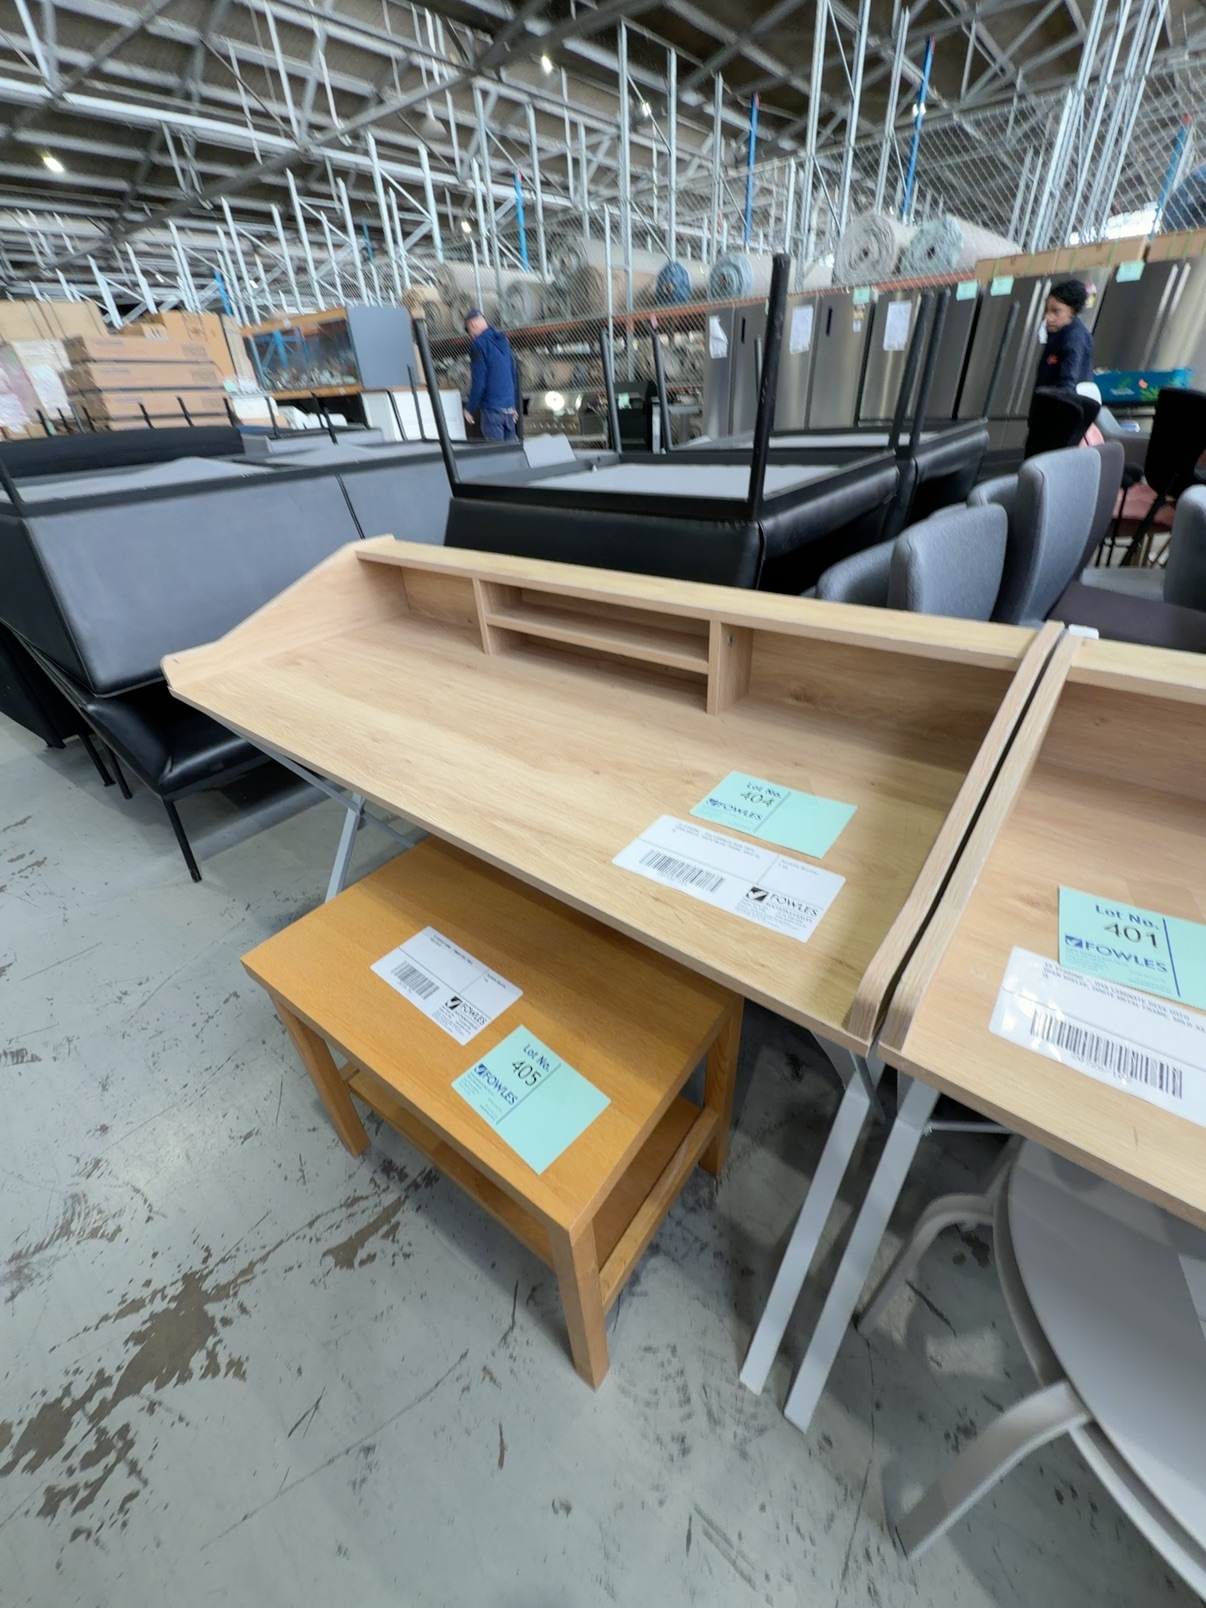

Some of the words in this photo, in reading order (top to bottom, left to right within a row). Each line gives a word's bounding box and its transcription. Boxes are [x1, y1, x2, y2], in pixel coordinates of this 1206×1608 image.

[740, 791, 775, 807] 404
[747, 781, 763, 792] Lot
[717, 802, 763, 820] FOWLES
[770, 893, 819, 916] FOWLES
[1095, 903, 1122, 920] Lot
[1129, 913, 1160, 931] No.
[1104, 922, 1157, 949] 401
[1084, 940, 1168, 973] FOWLES
[461, 1002, 488, 1026] FOWLES
[523, 1043, 539, 1060] Lot
[536, 1055, 550, 1073] No.
[512, 1060, 542, 1087] 405
[482, 1070, 518, 1106] FOWLES
